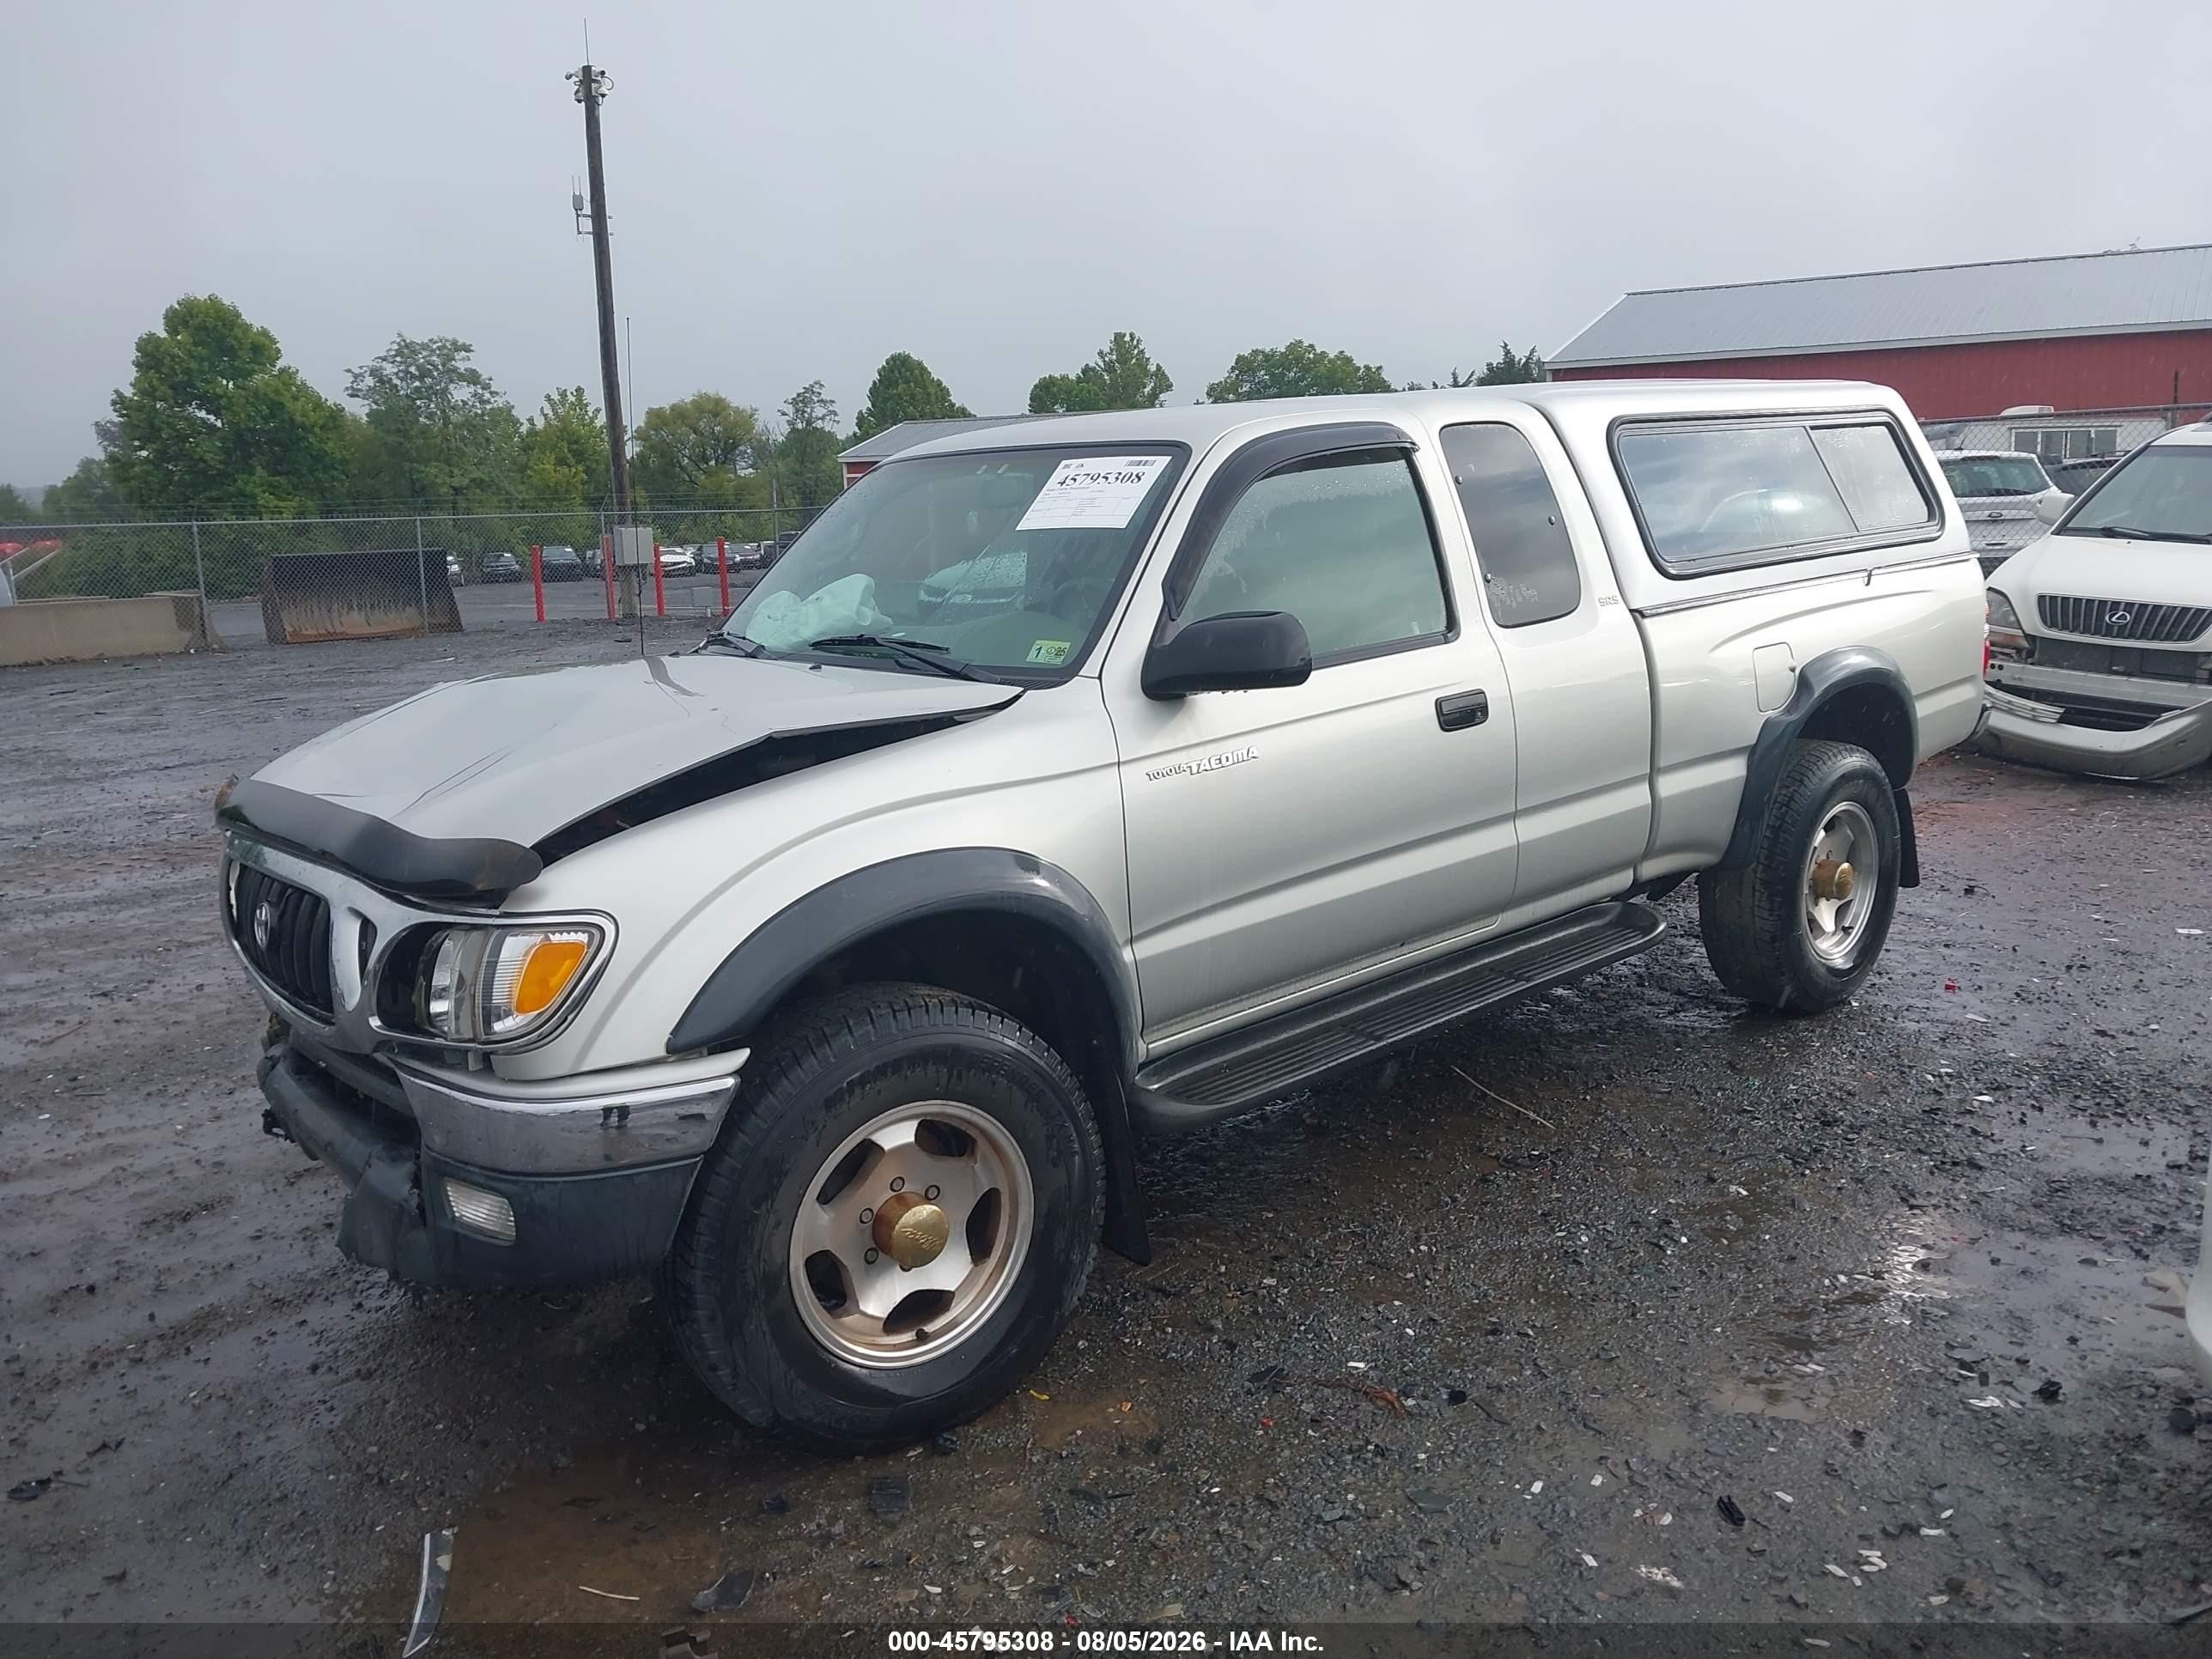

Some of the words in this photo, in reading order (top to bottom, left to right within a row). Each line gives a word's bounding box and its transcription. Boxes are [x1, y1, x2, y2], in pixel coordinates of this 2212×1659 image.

[1057, 471, 1146, 487] 45795308
[1035, 646, 1042, 659] 1
[1146, 764, 1188, 781] TOYOTA
[1188, 747, 1259, 775] TACOMA
